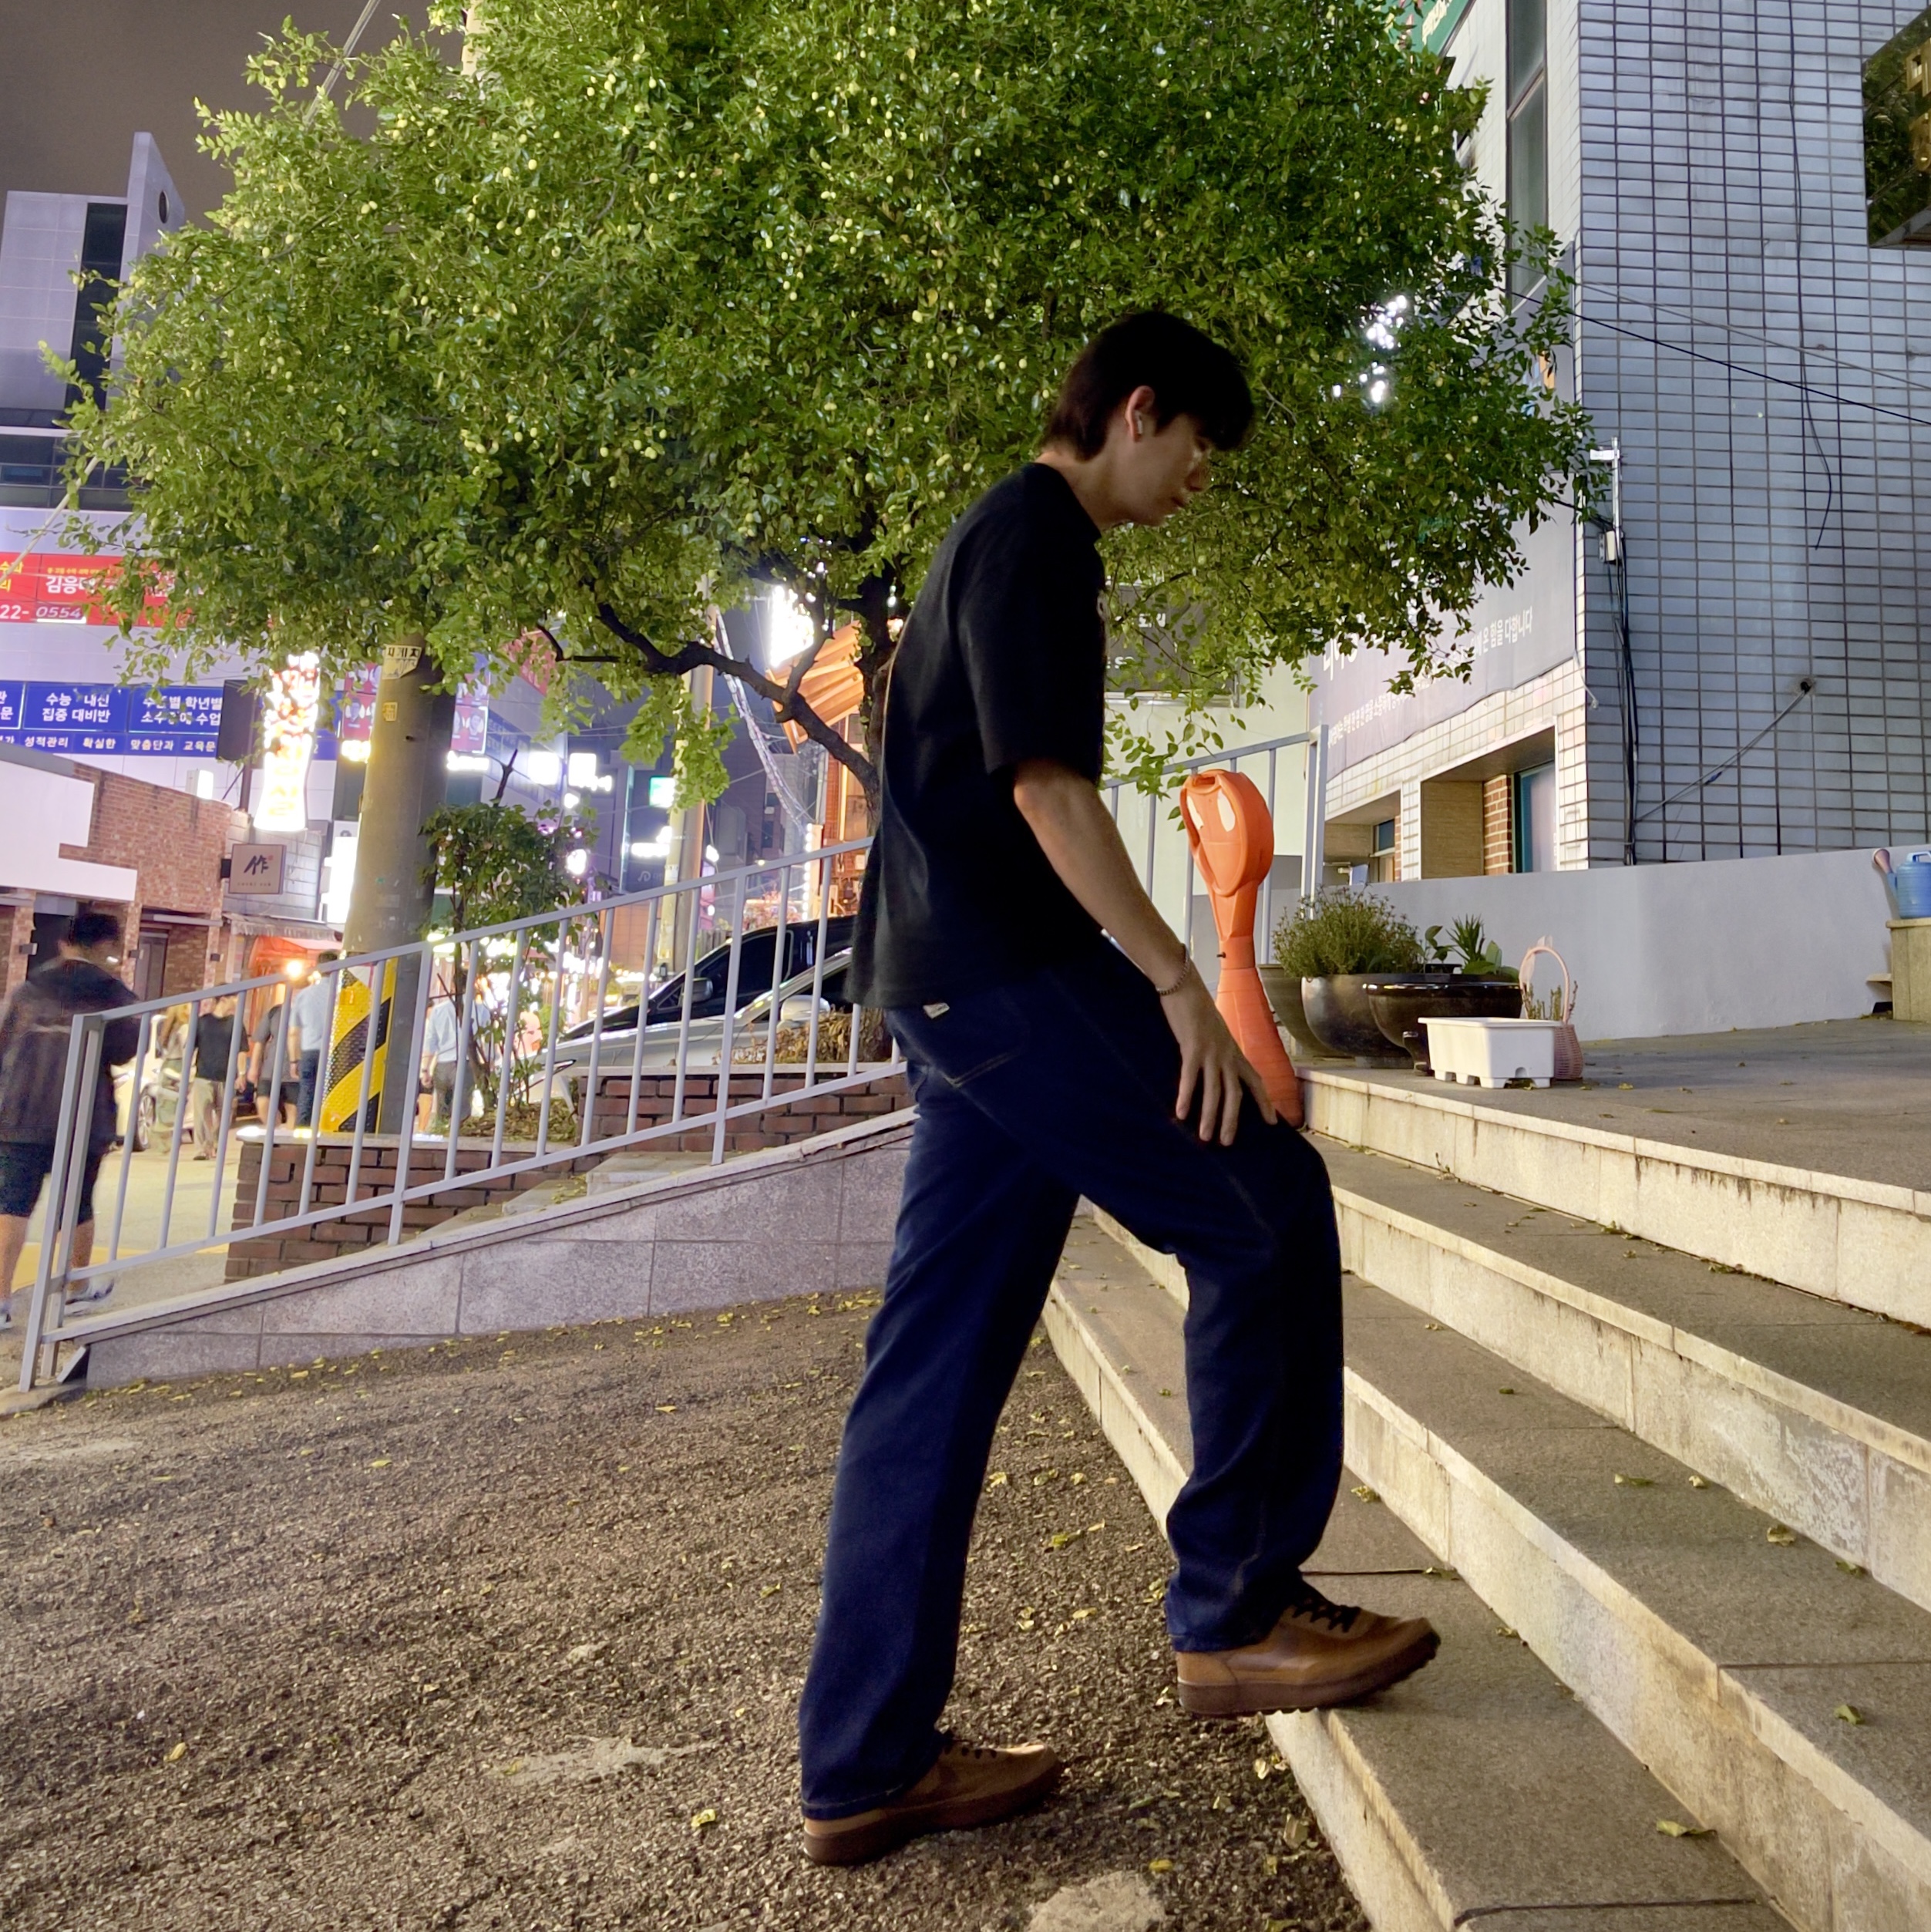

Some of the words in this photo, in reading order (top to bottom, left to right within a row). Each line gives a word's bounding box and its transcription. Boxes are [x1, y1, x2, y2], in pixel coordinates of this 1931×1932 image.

[1505, 605, 1532, 644] 다합니다
[46, 692, 72, 706] 수능
[84, 694, 109, 708] 내신
[185, 696, 223, 710] 학년별
[42, 708, 68, 722] 집중
[72, 709, 111, 722] 대비반
[195, 712, 221, 726] 수업
[25, 735, 69, 748] 성적관리
[82, 737, 116, 749] 확실한
